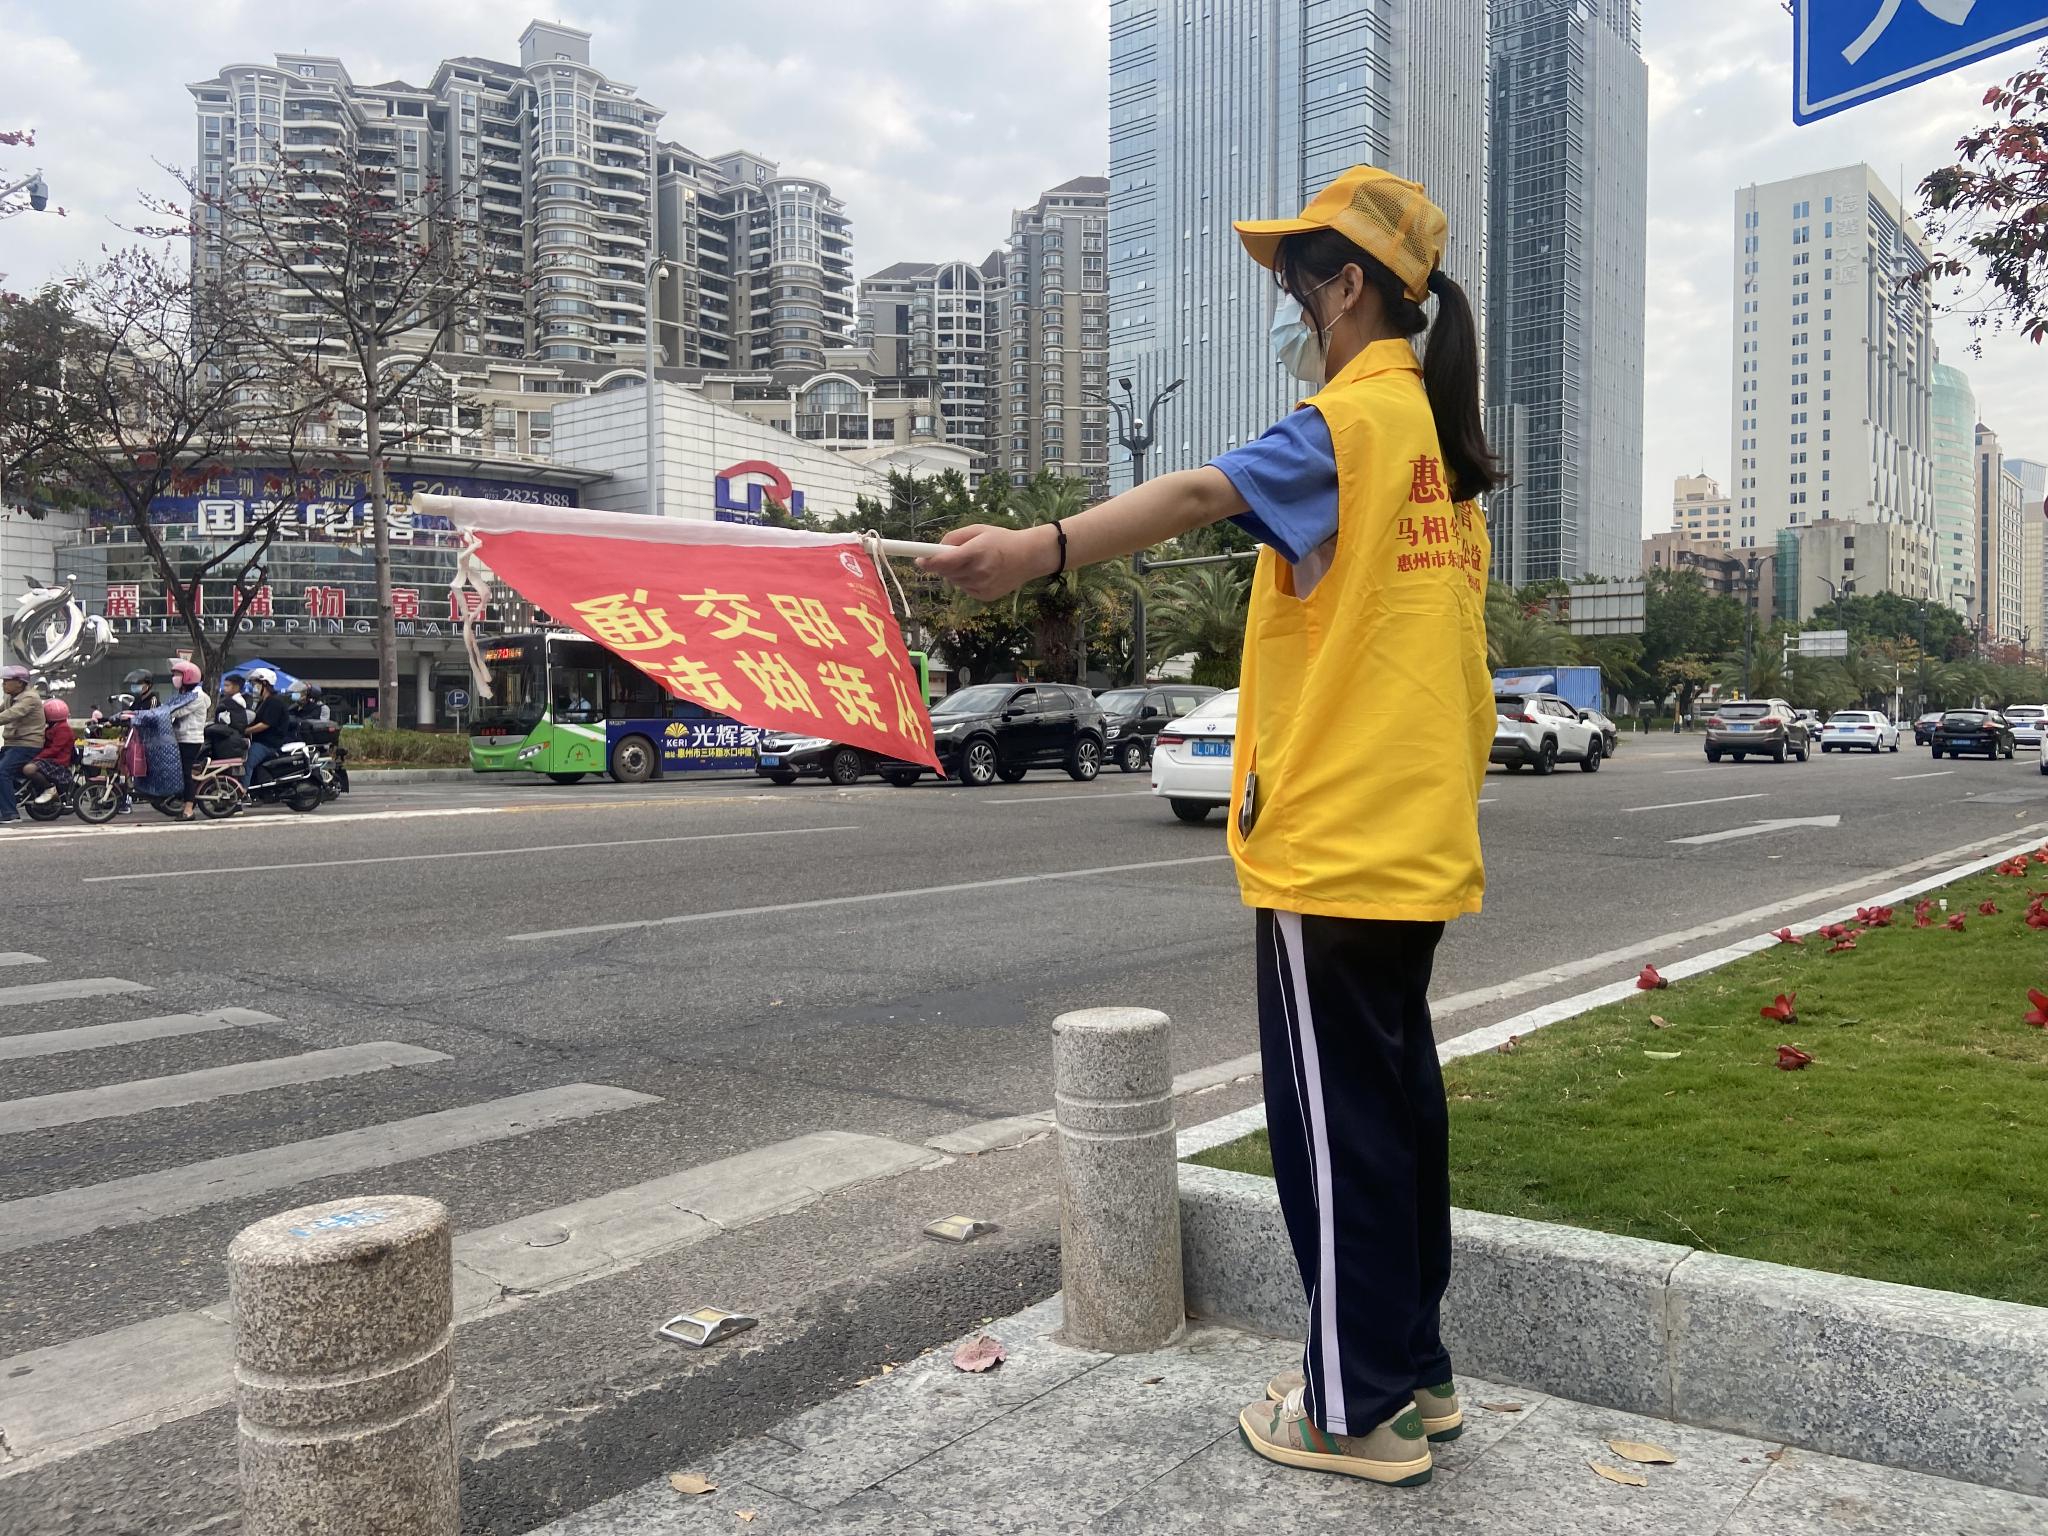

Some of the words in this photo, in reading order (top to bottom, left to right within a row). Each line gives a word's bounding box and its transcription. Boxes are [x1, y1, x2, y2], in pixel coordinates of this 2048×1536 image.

[197, 499, 414, 540] 国美电器
[197, 618, 371, 634] SHOPPING
[397, 621, 487, 637] MALL
[454, 691, 464, 704] P
[666, 738, 688, 748] KERI
[692, 723, 776, 747] 光辉家
